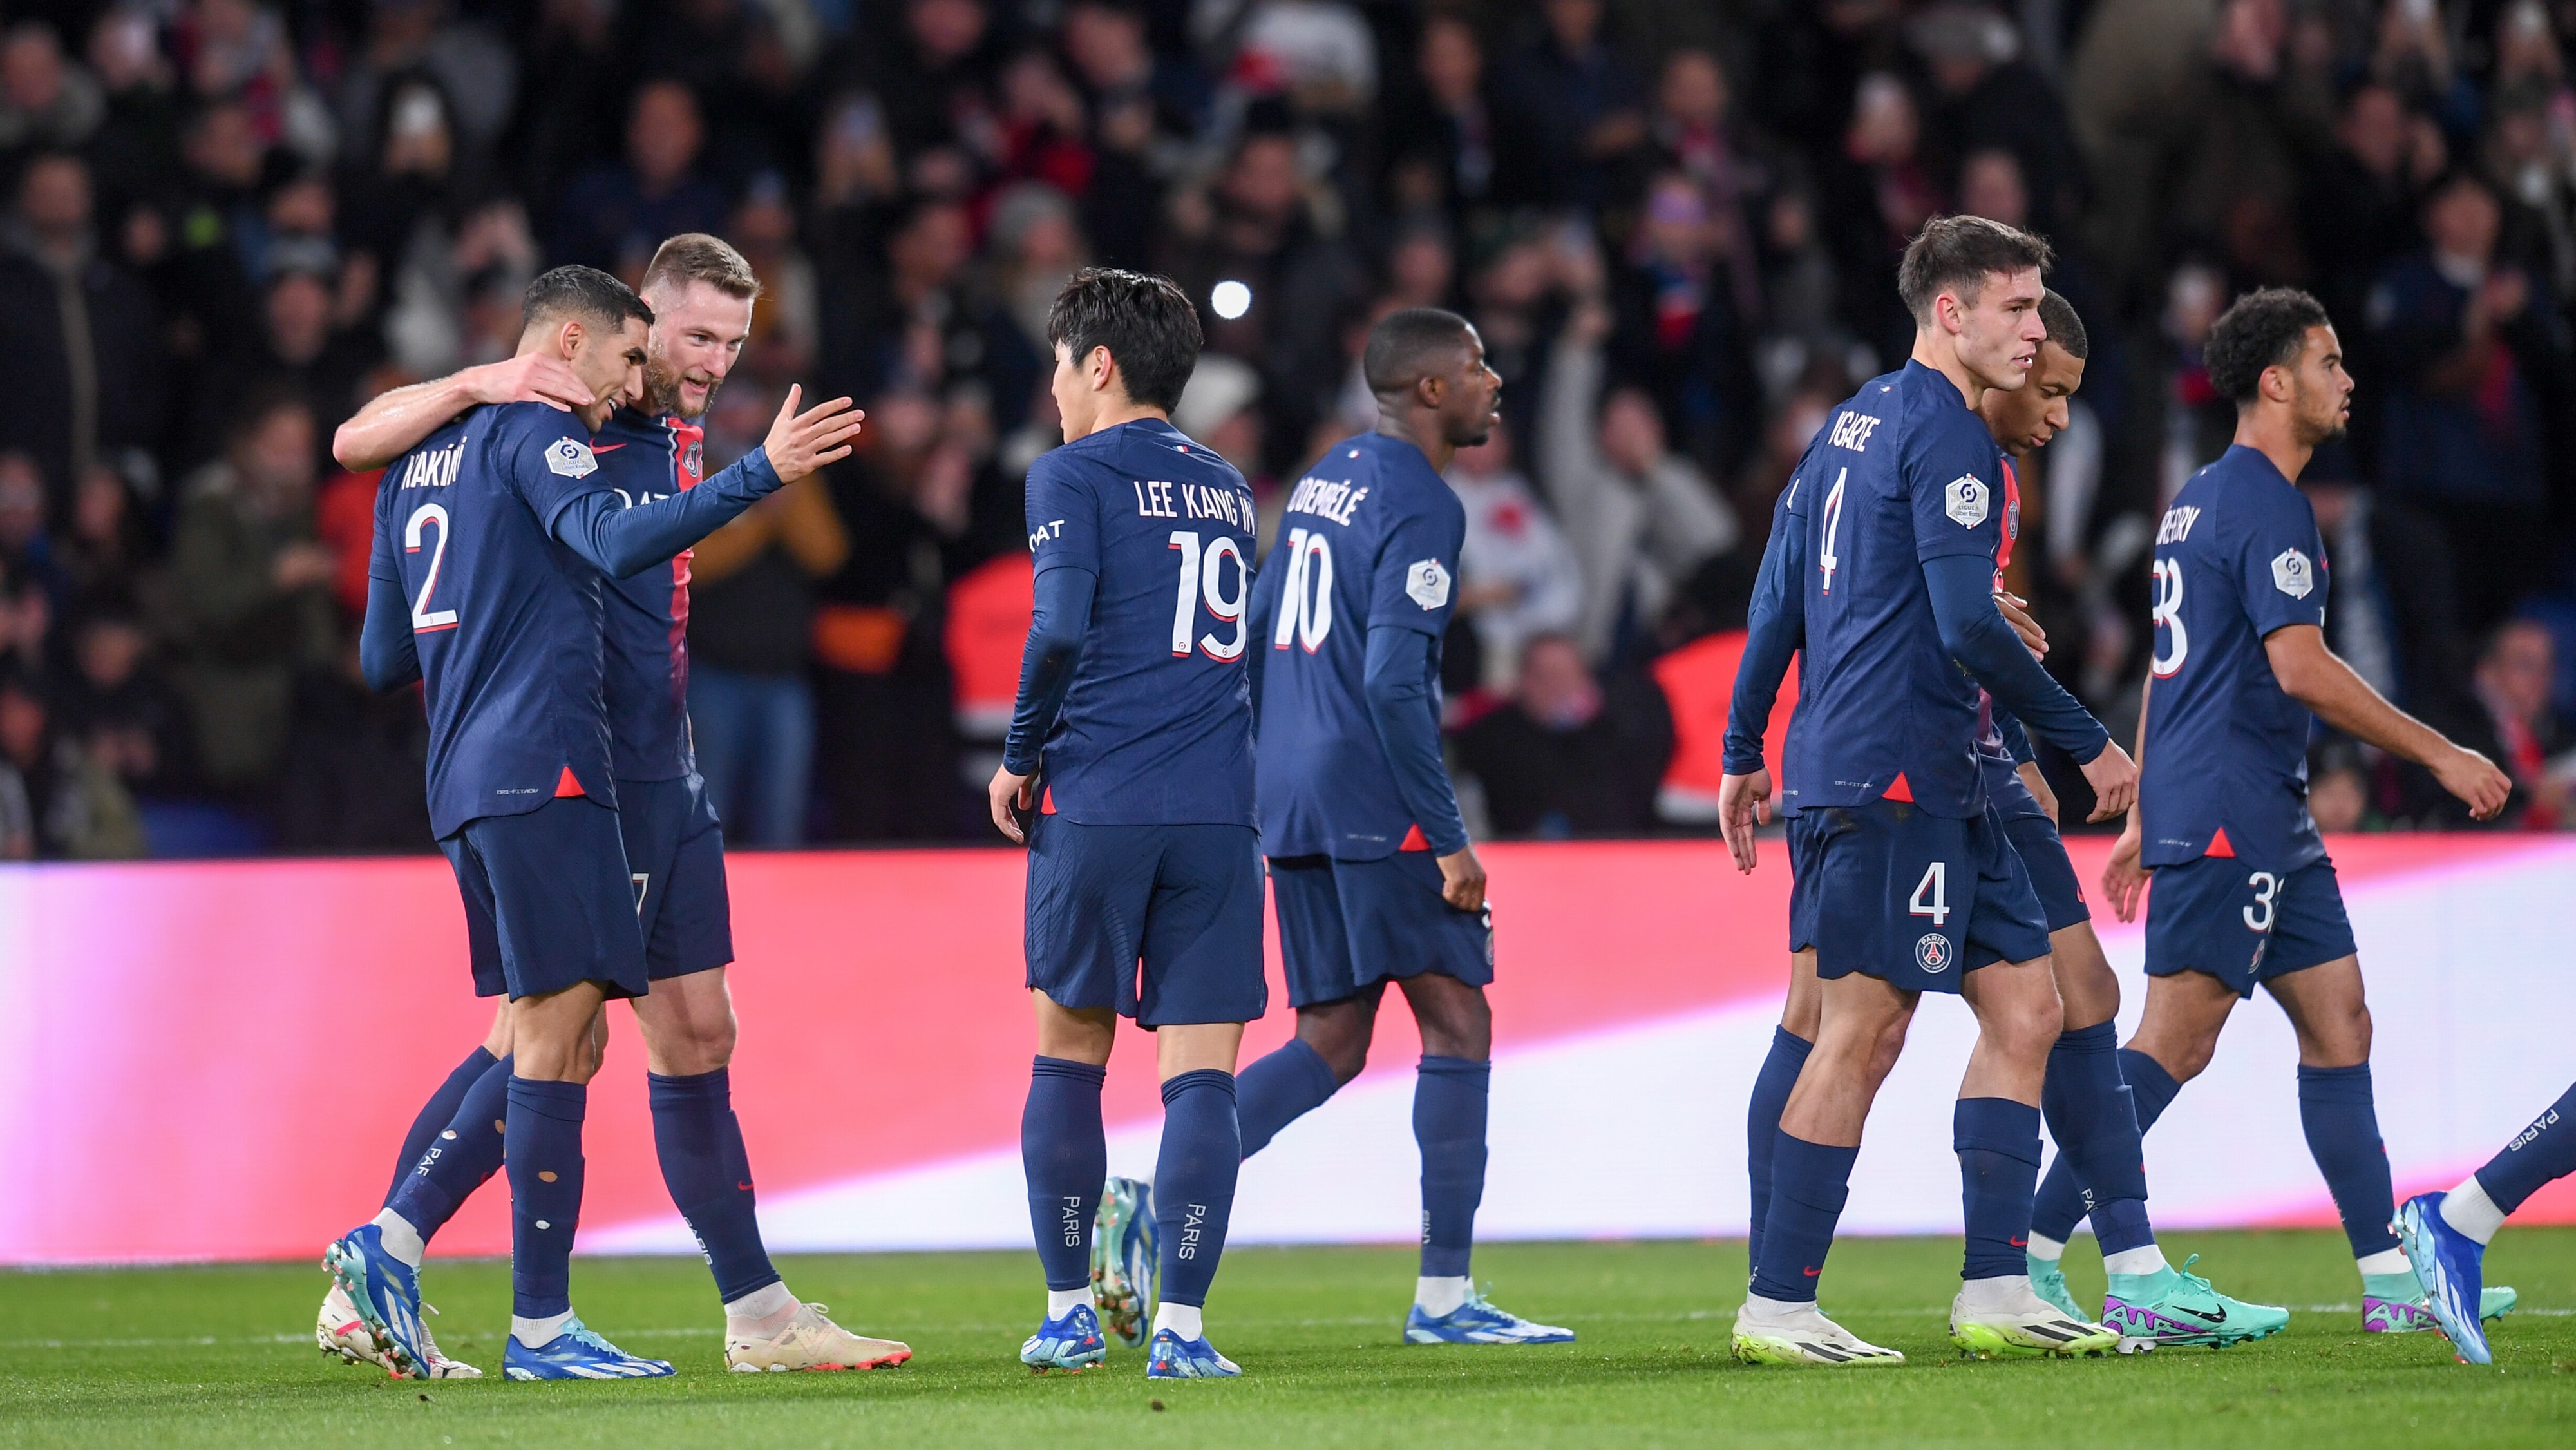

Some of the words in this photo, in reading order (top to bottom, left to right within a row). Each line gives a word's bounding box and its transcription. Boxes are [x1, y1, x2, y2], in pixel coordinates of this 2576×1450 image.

[1133, 481, 1177, 517] LEE
[1182, 483, 1238, 526] KANG
[1819, 467, 1847, 595] 4
[405, 503, 458, 634] 2
[1168, 531, 1247, 663] 19
[1275, 528, 1332, 655] 10
[1909, 862, 1950, 927] 4
[2243, 872, 2284, 934] 3
[1921, 935, 1946, 945] PARIS
[2509, 1108, 2559, 1152] PARIS
[1063, 1196, 1081, 1247] PARIS
[1178, 1203, 1206, 1261] PARIS
